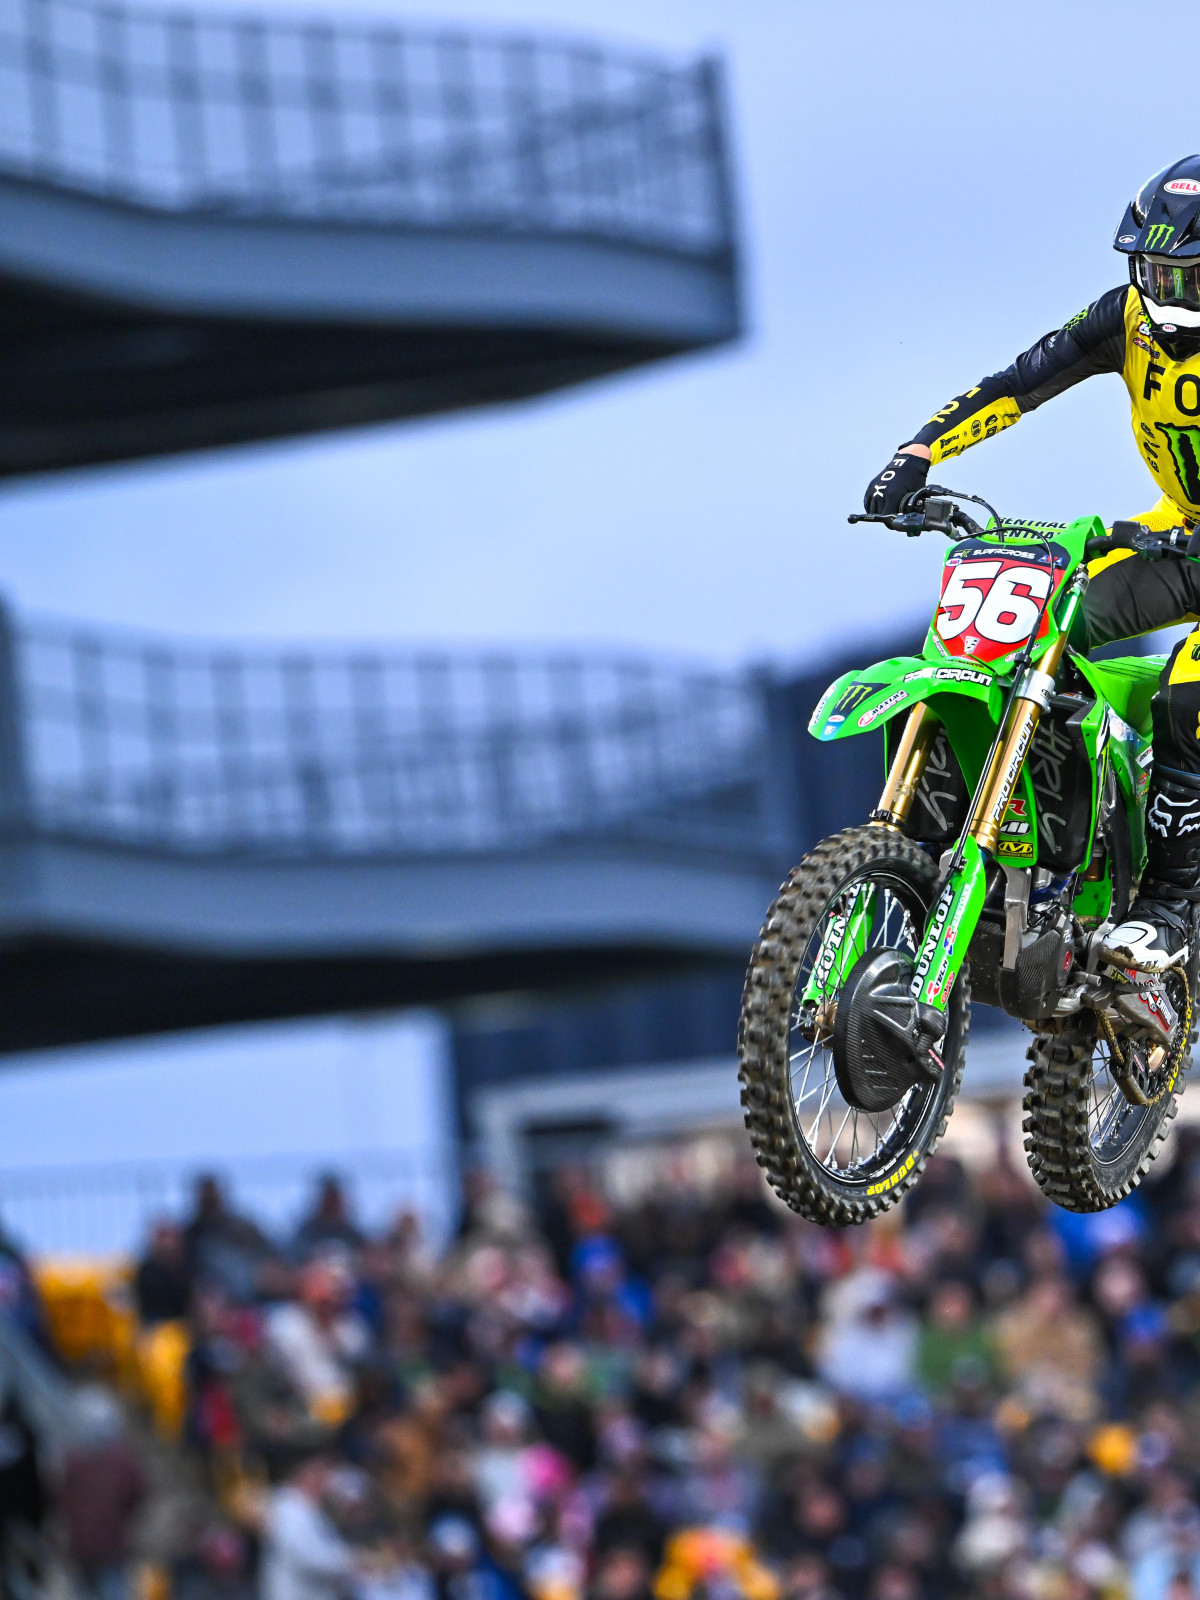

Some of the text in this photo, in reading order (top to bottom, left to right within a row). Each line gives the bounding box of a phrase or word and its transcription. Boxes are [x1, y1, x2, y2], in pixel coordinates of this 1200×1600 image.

[1171, 182, 1198, 192] BELL
[872, 458, 906, 498] FOX
[936, 561, 1051, 643] 56
[871, 690, 905, 716] MAXIMA
[992, 713, 1034, 821] PRO CIRCUIT
[911, 884, 955, 999] DUNLOP
[867, 1154, 915, 1196] DUNLOP
